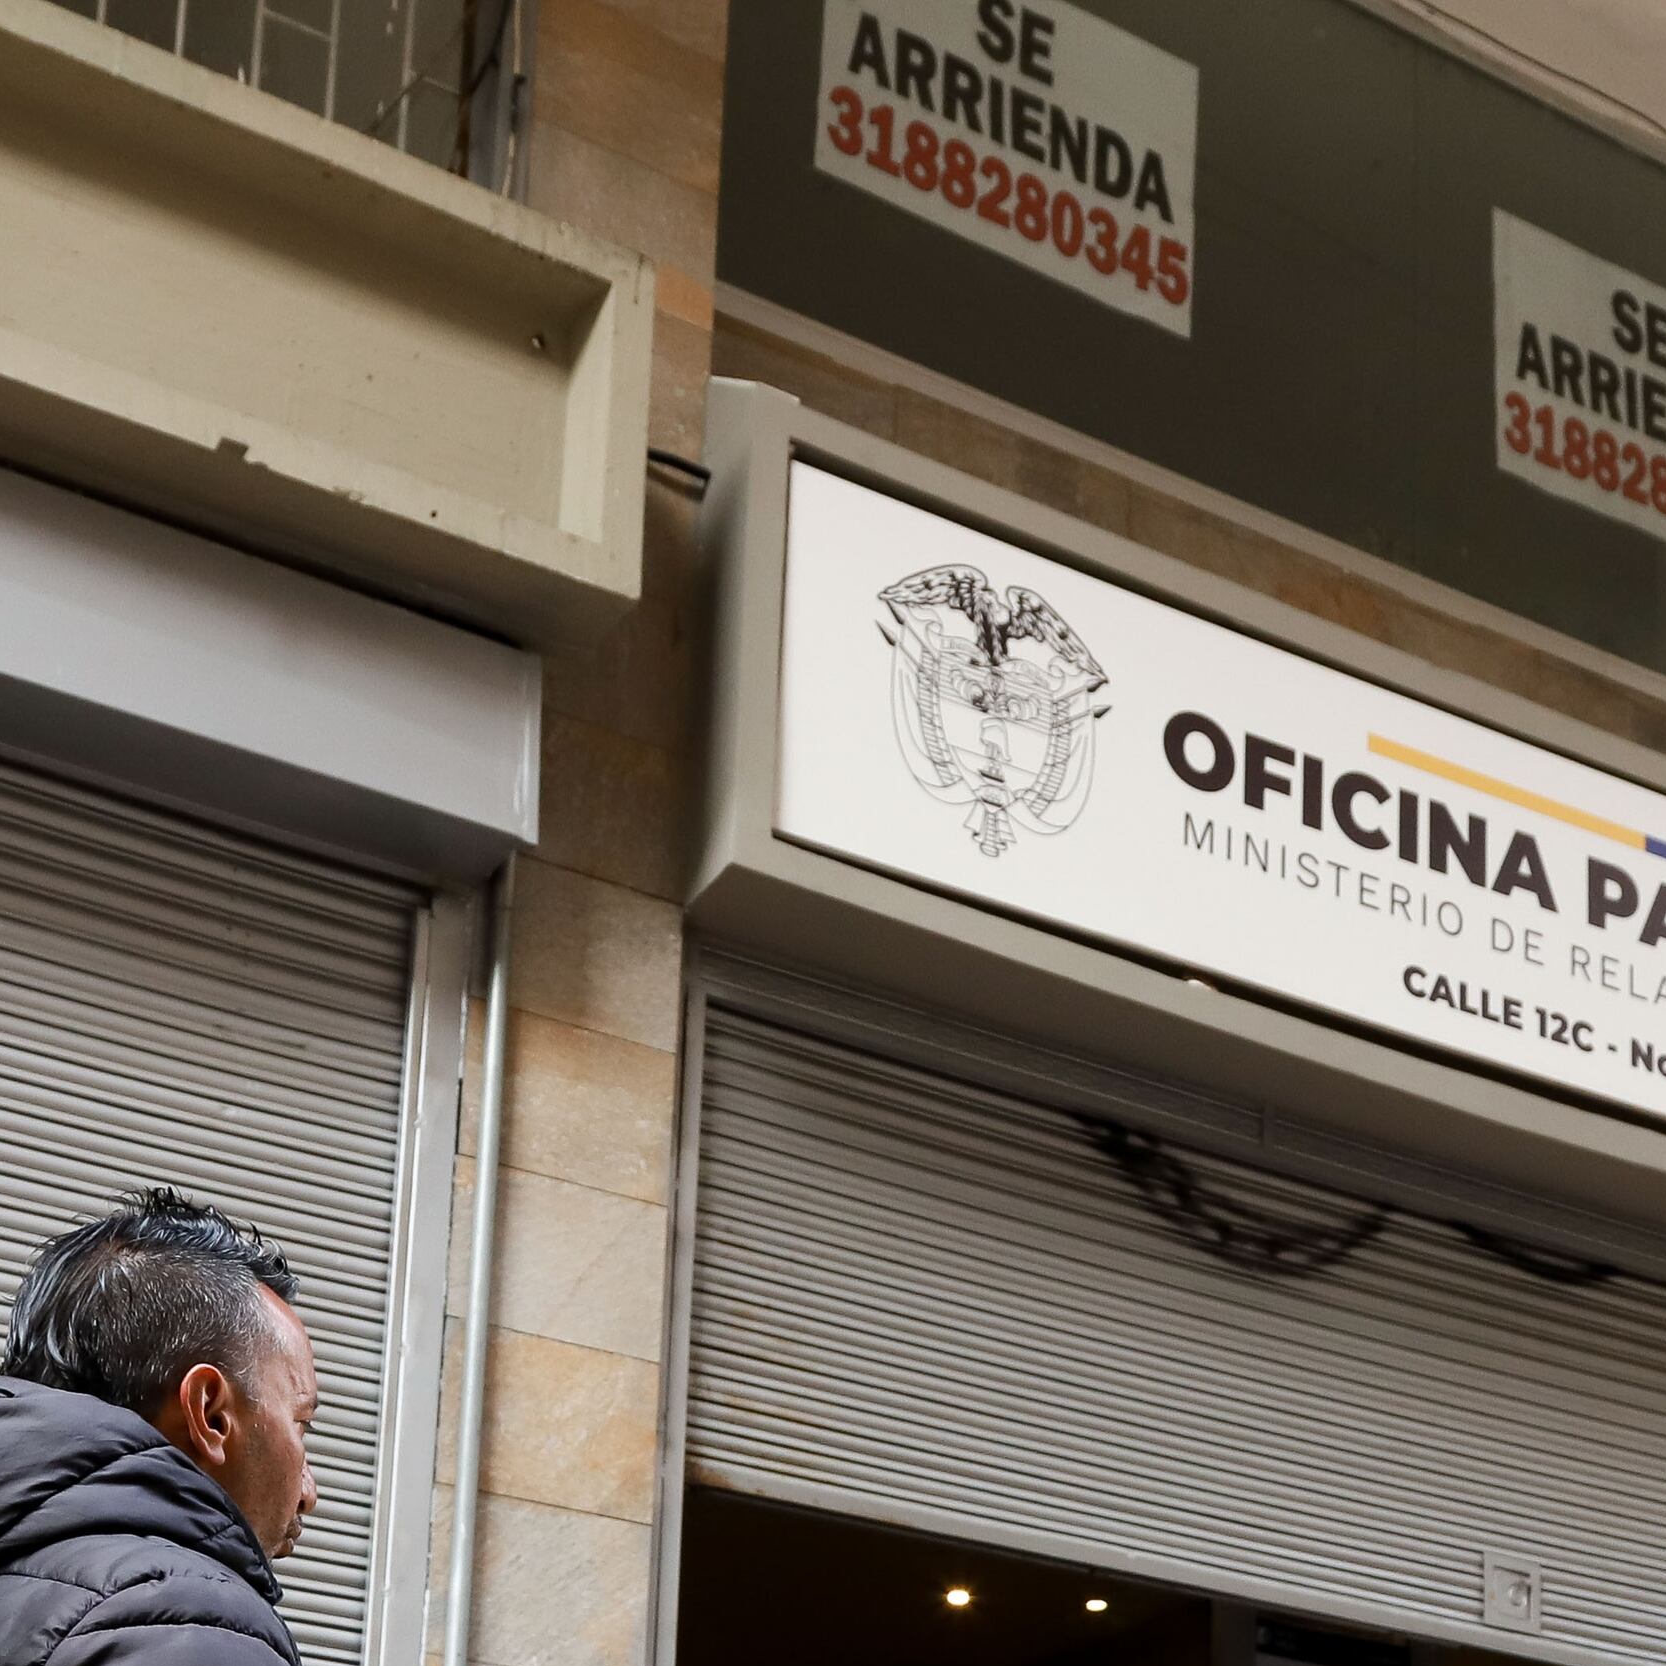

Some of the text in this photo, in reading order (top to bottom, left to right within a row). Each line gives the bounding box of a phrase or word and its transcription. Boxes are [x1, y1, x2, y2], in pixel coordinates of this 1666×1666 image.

[847, 10, 1175, 225] ARRIENDA
[977, 0, 1056, 87] SE
[827, 83, 1190, 306] 3188280345
[1162, 709, 1559, 914] OFICINA
[1182, 811, 1464, 938] MINISTERIO
[1491, 916, 1545, 967] DE
[1402, 965, 1524, 1031] CALLE
[1535, 1006, 1595, 1053] 12C
